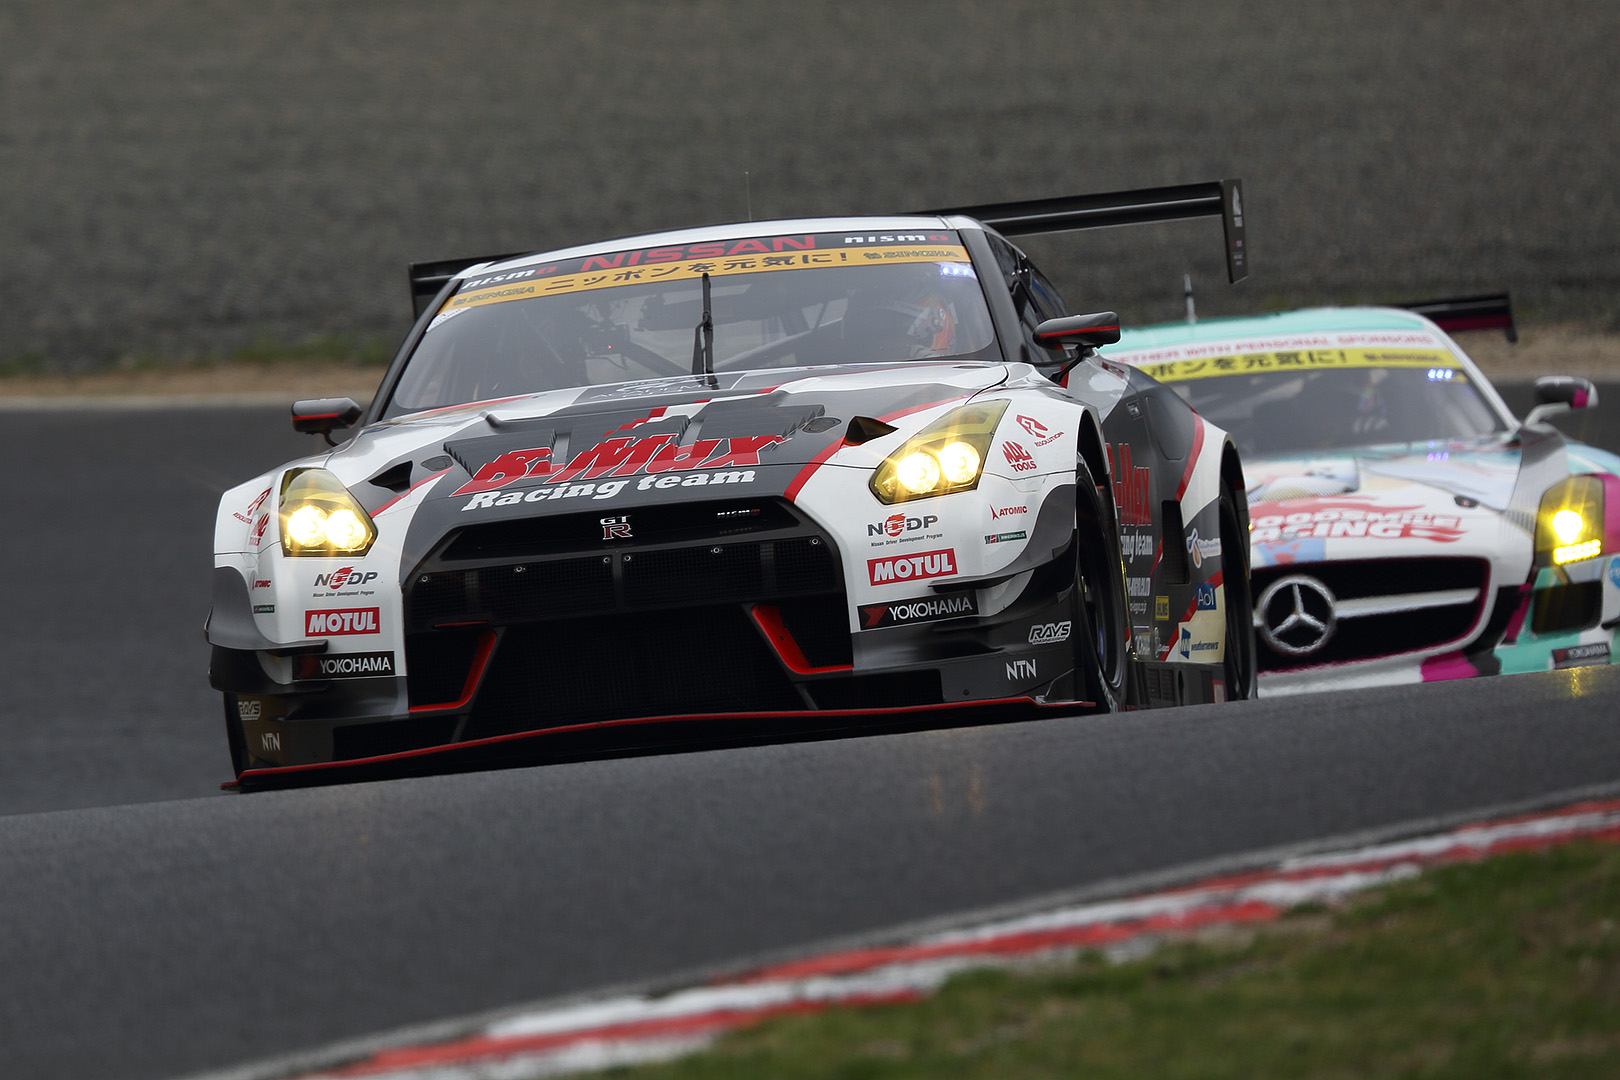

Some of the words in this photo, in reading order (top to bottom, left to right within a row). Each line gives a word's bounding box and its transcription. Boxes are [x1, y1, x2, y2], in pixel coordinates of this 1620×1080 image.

[844, 233, 949, 244] nismo
[580, 236, 816, 272] NISSAN
[461, 266, 557, 290] nismo
[1010, 461, 1037, 472] TOOLS
[461, 475, 630, 512] Racing
[636, 468, 756, 492] team
[600, 515, 632, 525] GT
[999, 505, 1028, 517] ATOMIC
[602, 523, 634, 541] R
[873, 553, 953, 582] MOTUL
[888, 596, 973, 621] YOKOHAMA
[307, 611, 377, 633] MOTUL
[1029, 621, 1071, 643] RAYS
[320, 656, 392, 674] YOKOHAMA
[1005, 658, 1037, 681] NTN
[261, 732, 281, 751] NTN
